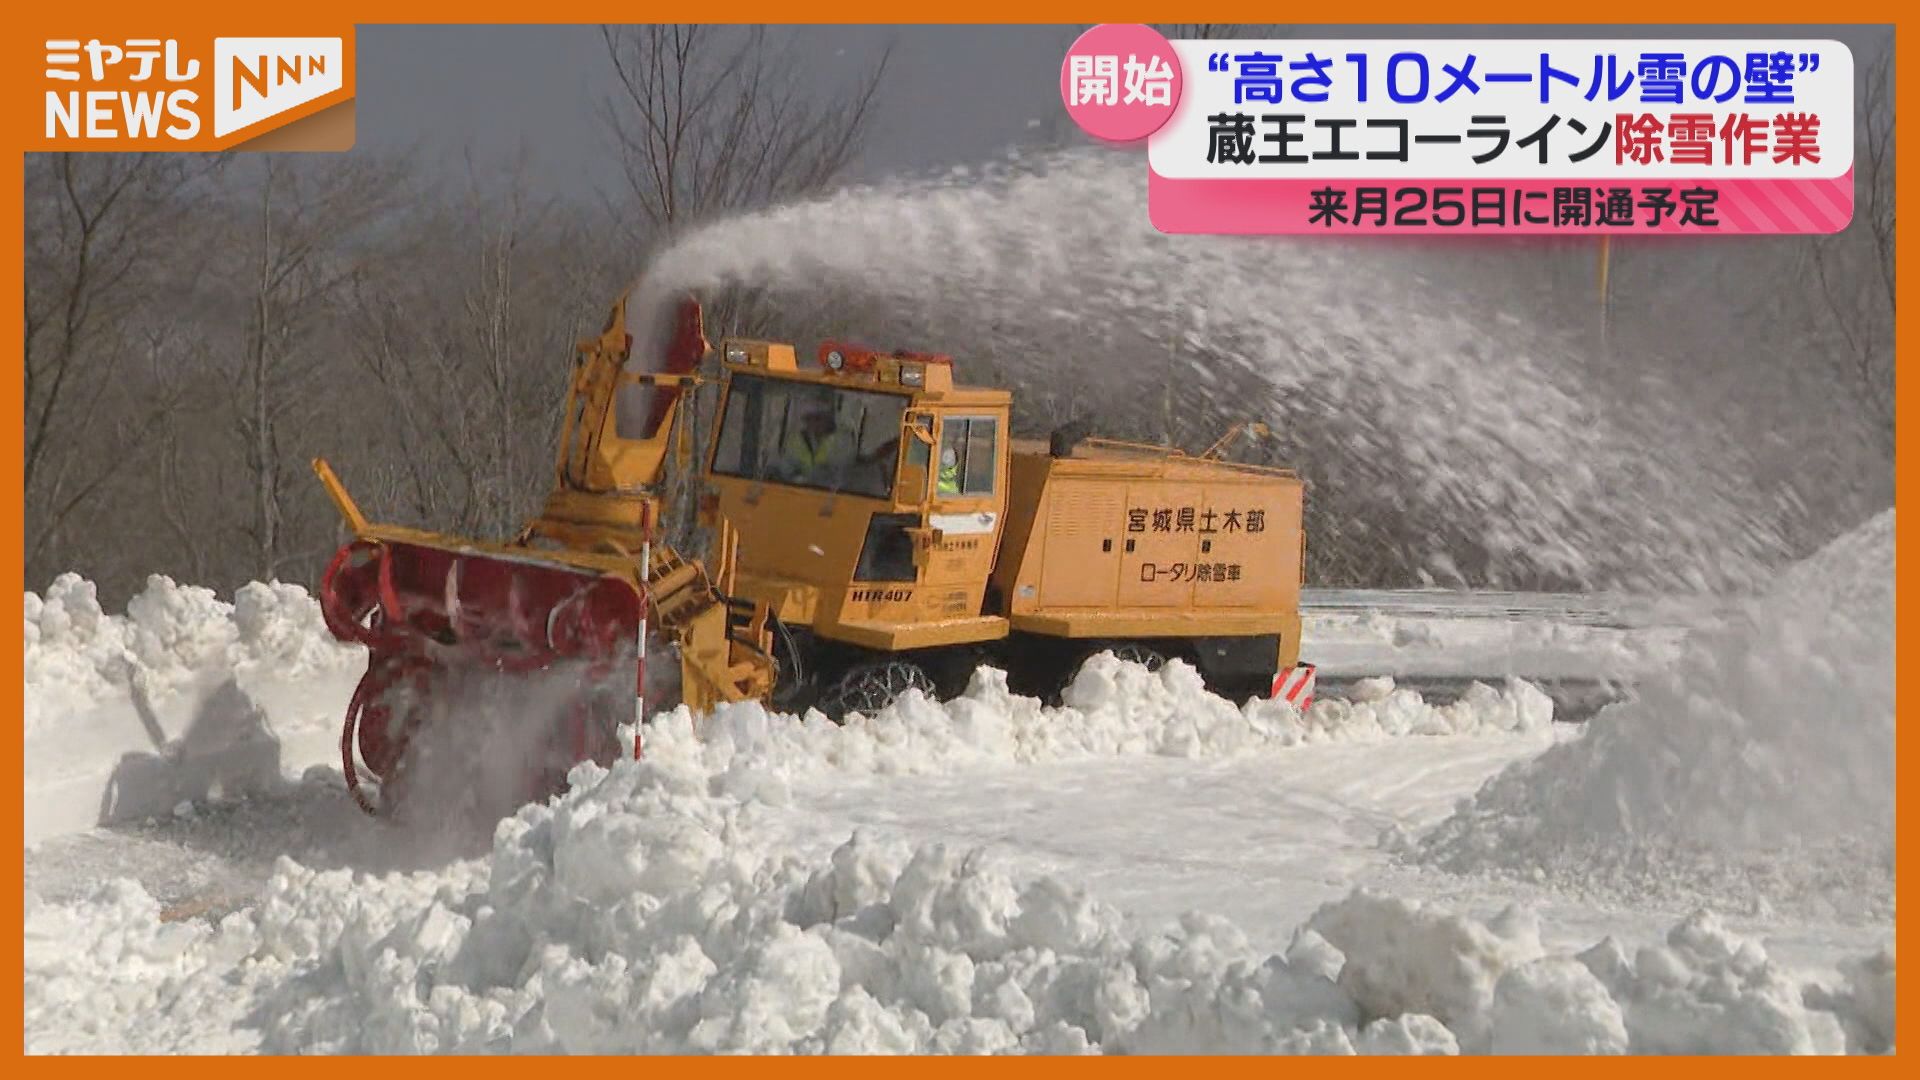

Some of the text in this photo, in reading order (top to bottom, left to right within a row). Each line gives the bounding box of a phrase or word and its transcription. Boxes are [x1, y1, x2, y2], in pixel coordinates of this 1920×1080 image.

[1127, 506, 1266, 534] 宮城県土木部
[1140, 562, 1242, 583] ロータリ除雪車
[851, 590, 913, 602] HTR407
